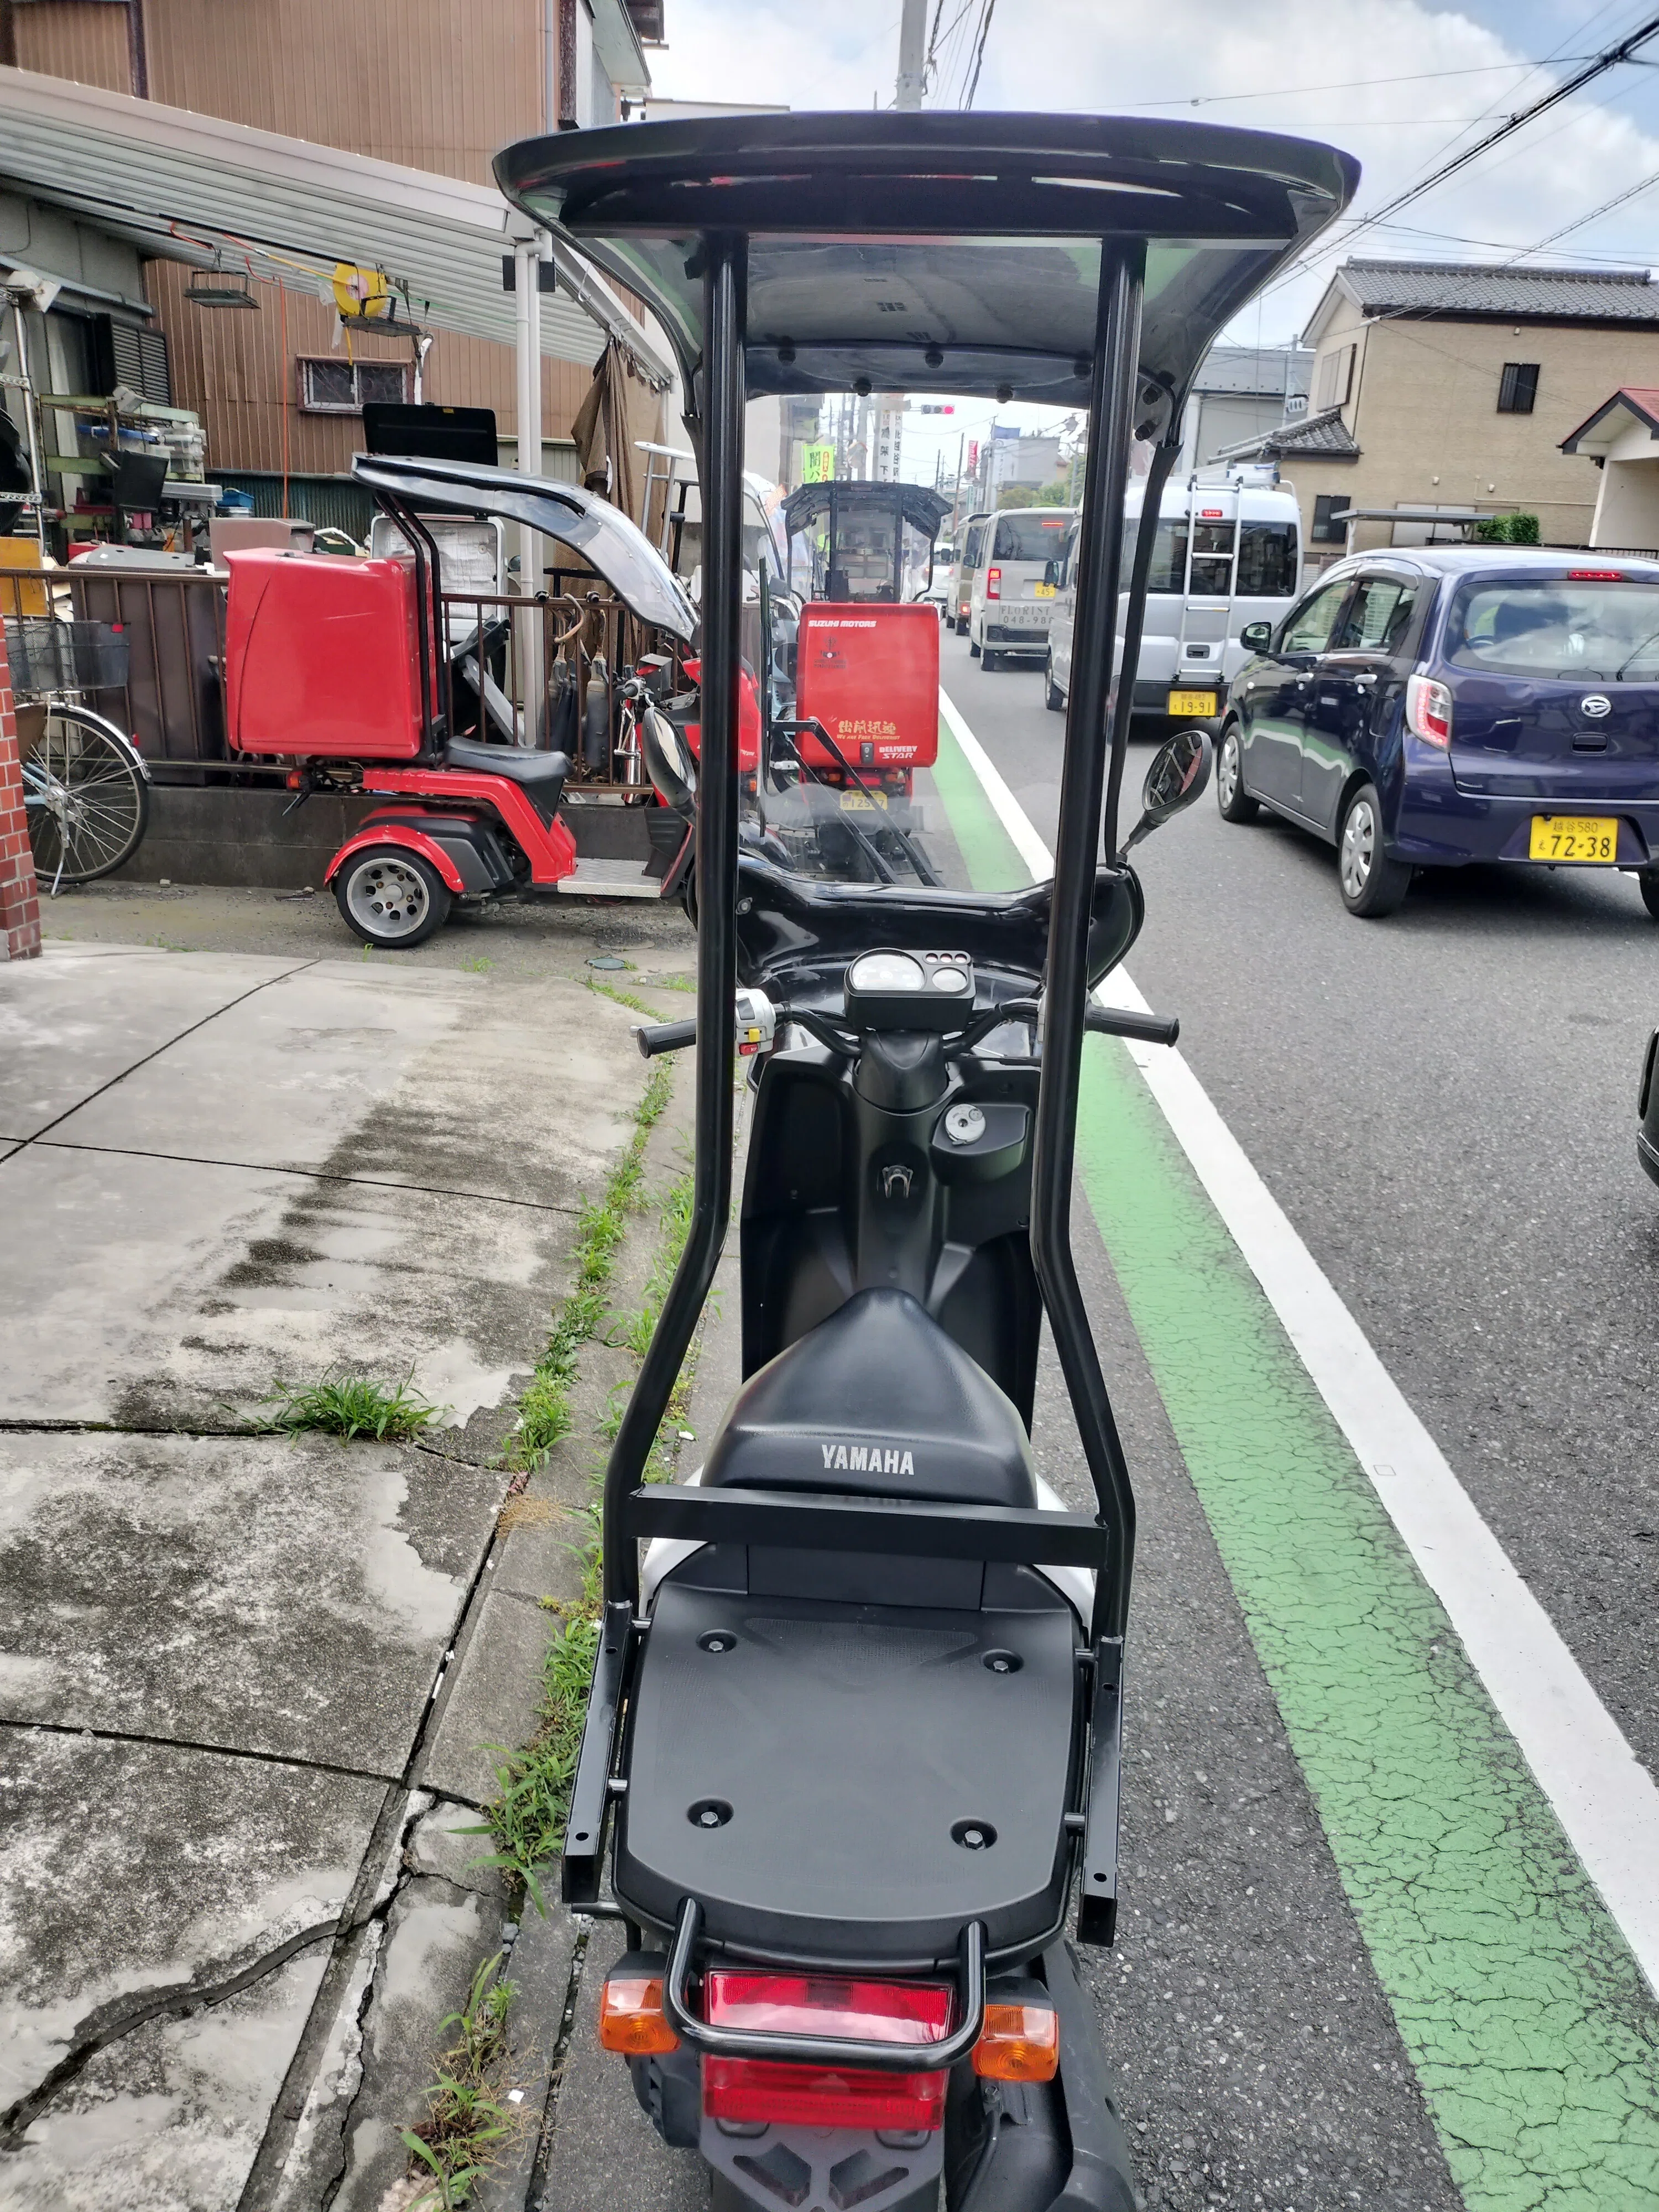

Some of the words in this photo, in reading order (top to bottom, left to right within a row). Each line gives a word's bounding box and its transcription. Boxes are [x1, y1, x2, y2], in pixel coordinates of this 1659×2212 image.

[1001, 606, 1050, 615] FLORIST
[1182, 701, 1211, 713] 19-91
[838, 720, 896, 734] 出前迅速
[852, 799, 884, 807] 1257
[1551, 836, 1610, 857] 72-38
[822, 1444, 914, 1475] YAMAHA
